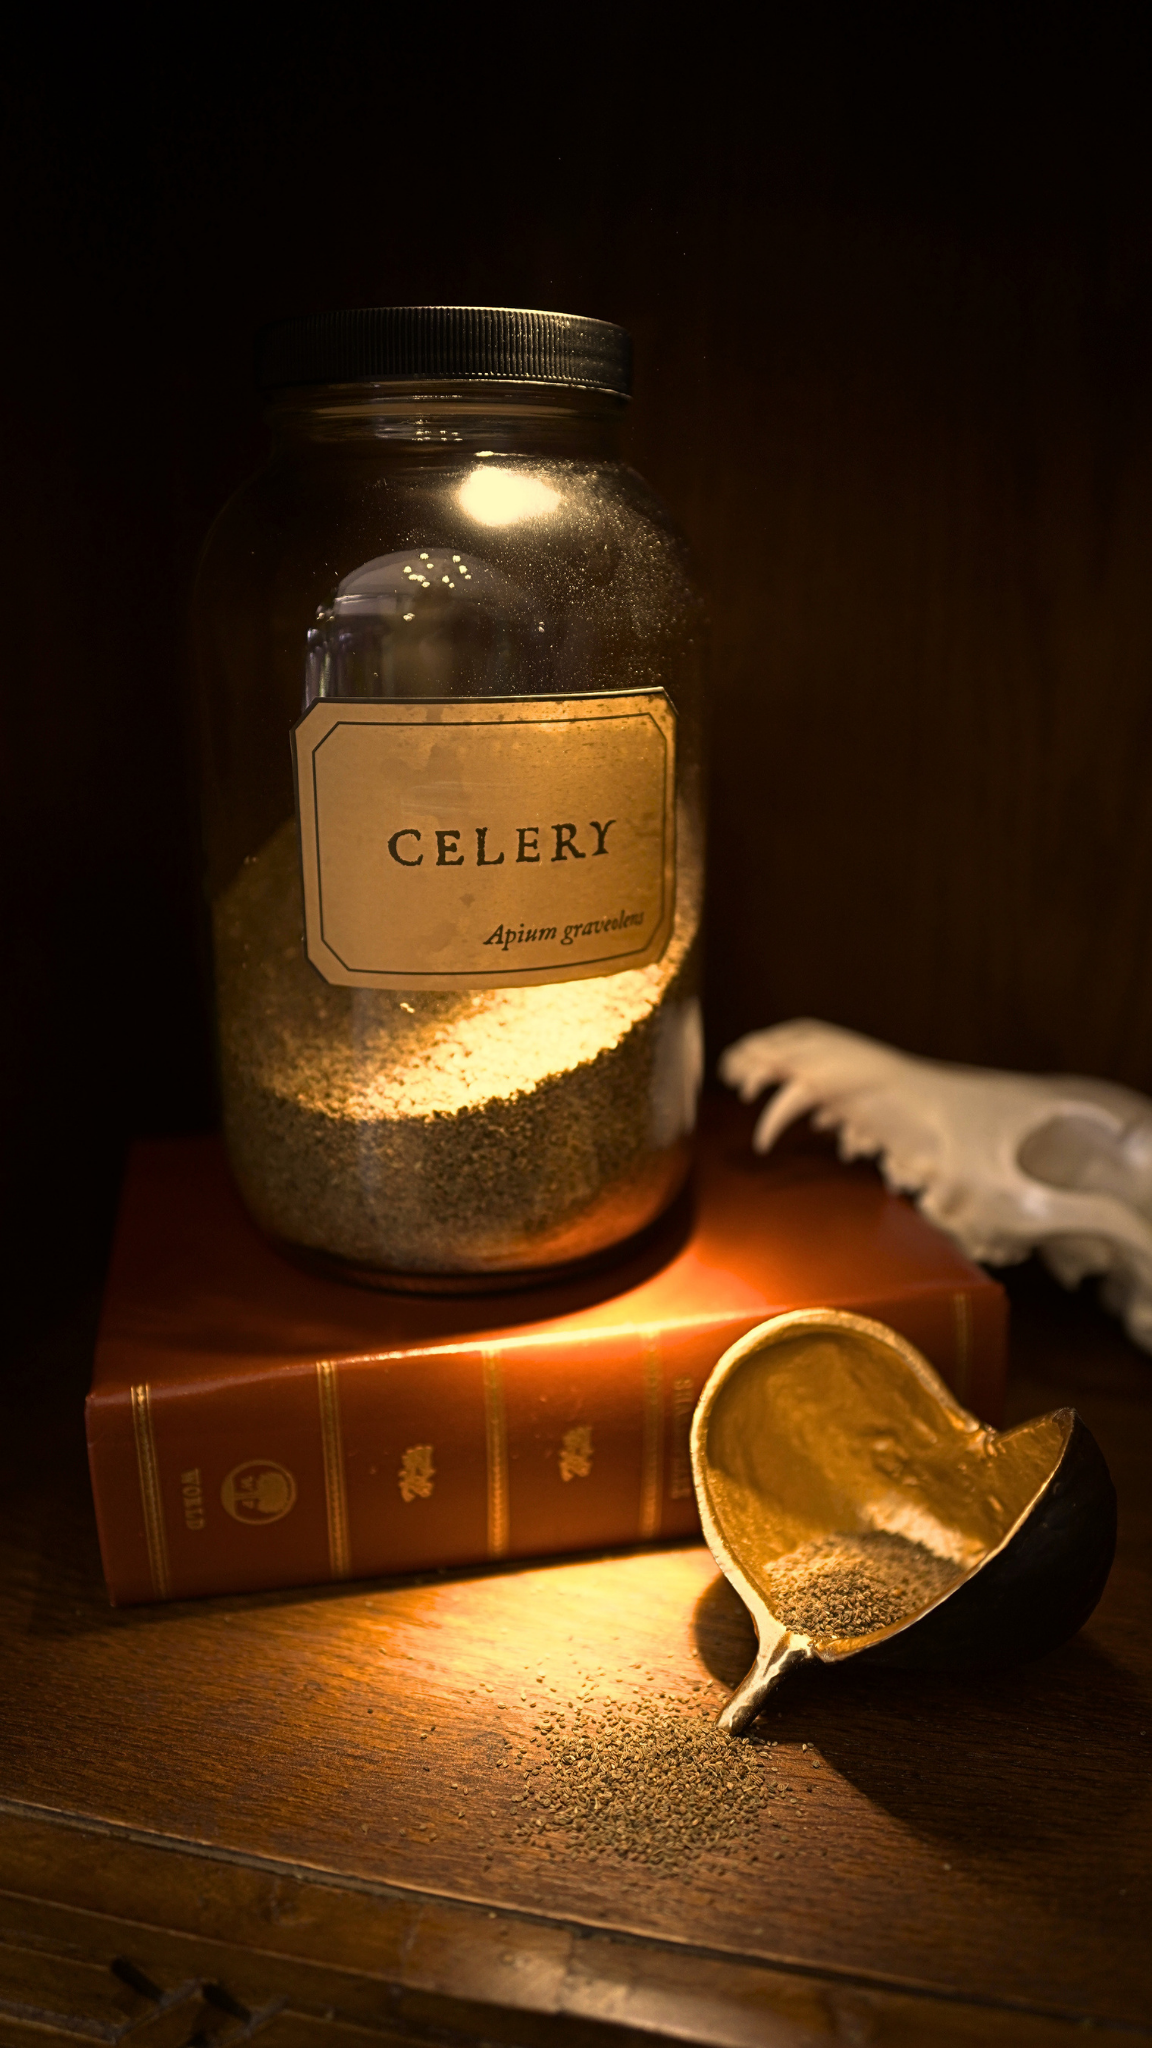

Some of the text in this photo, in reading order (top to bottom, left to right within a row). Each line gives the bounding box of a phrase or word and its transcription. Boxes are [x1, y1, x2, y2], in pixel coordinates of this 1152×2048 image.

[387, 819, 617, 867] CELERY
[482, 909, 645, 951] Apium graveolens
[181, 1467, 205, 1530] WORLD
